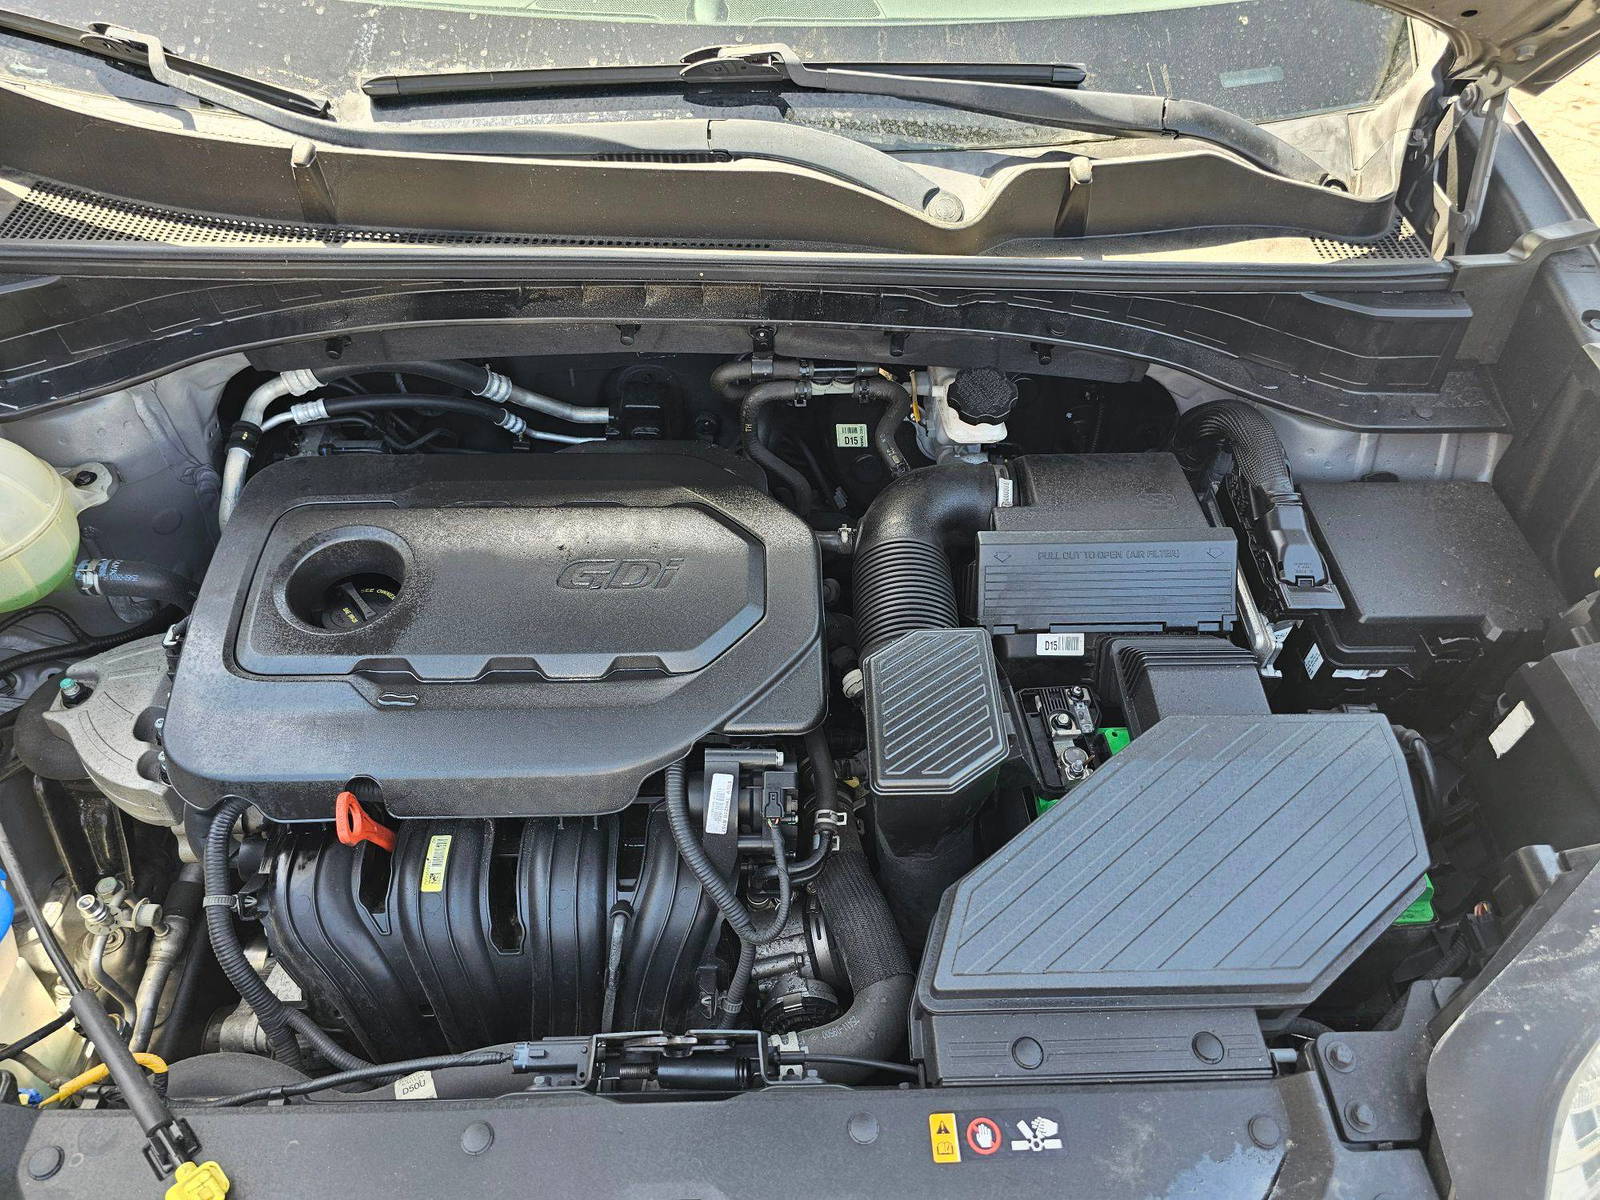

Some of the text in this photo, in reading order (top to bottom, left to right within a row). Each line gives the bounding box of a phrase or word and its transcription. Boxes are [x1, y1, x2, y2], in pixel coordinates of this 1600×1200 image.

[844, 436, 859, 446] D15
[1037, 551, 1060, 560] PULL
[1096, 550, 1122, 560] OPEN
[1044, 640, 1058, 651] D15
